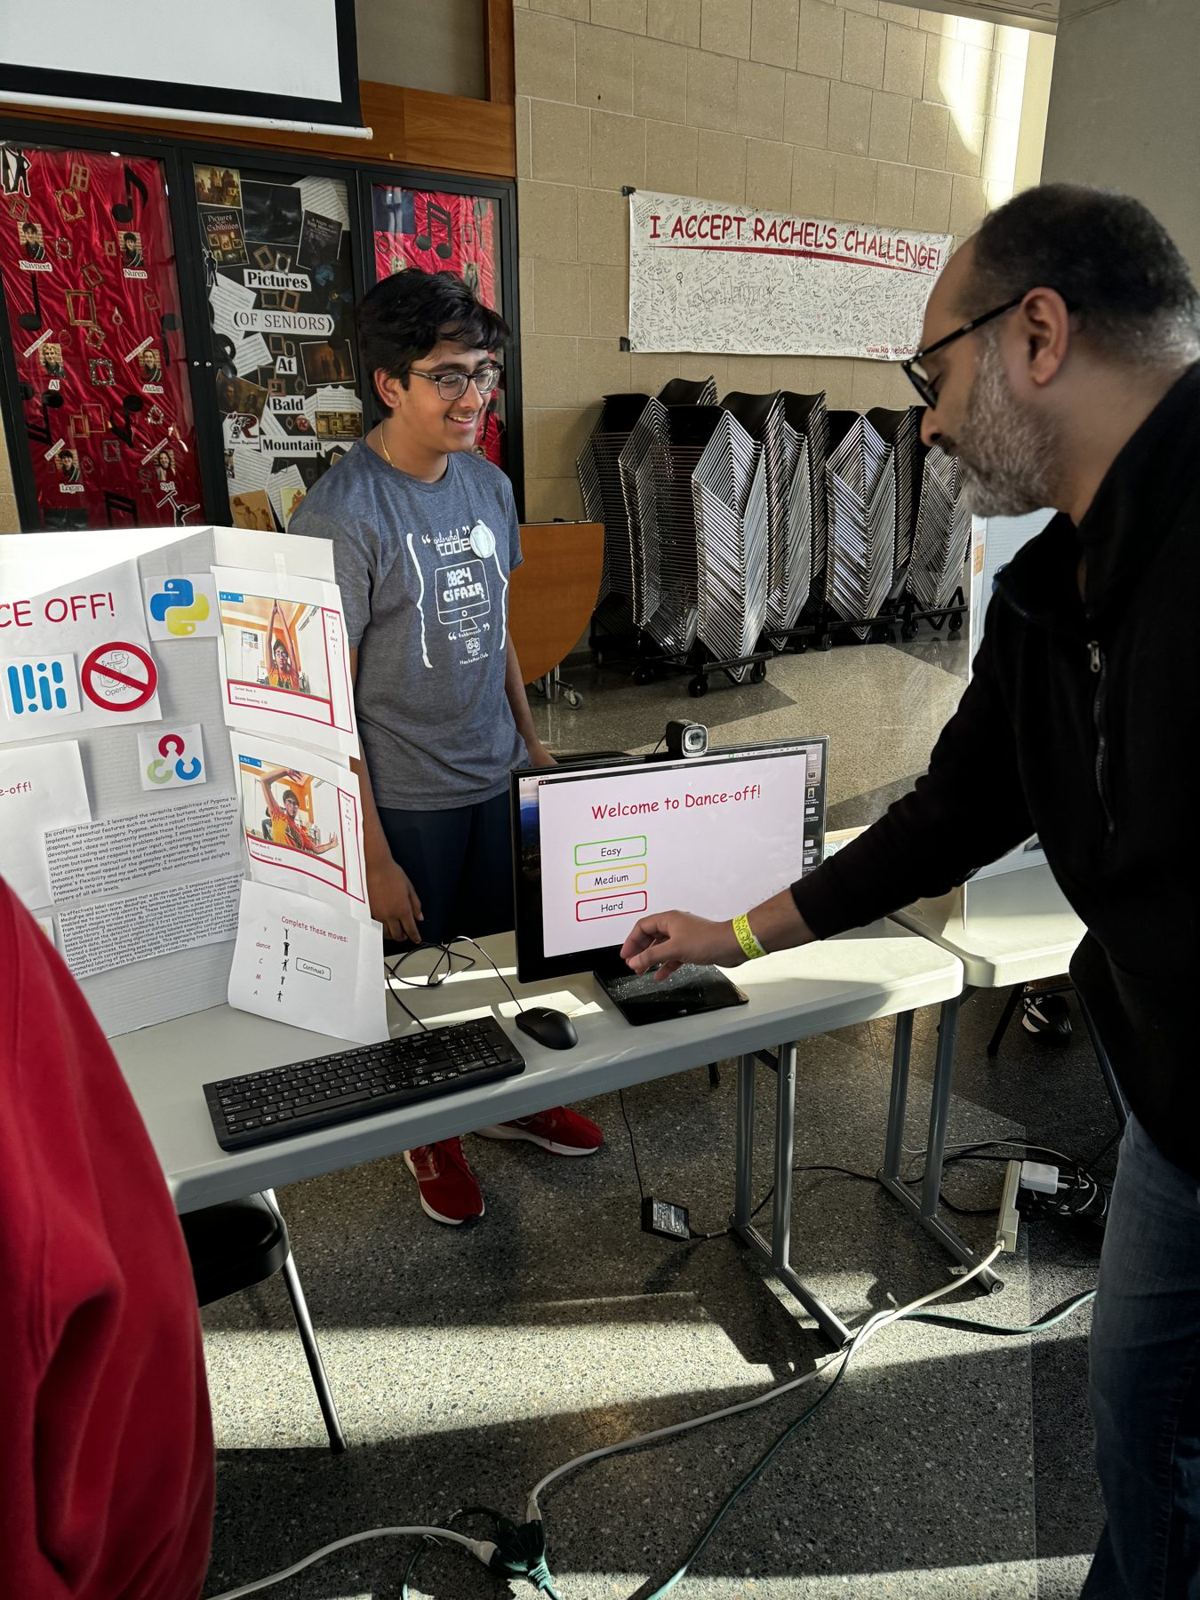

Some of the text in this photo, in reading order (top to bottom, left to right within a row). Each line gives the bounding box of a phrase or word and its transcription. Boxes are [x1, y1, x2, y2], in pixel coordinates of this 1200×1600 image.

[650, 213, 942, 270] I ACCEPT RACHEL'S CHALLENGE!
[248, 272, 308, 289] Pictures
[234, 311, 334, 334] (OF SENIORS)
[278, 358, 293, 372] At
[273, 398, 304, 411] Bald
[262, 439, 322, 452] Mountain
[45, 592, 115, 622] OFF!
[592, 784, 761, 820] Welcome to Dance-off!
[601, 846, 622, 858] Easy
[594, 873, 629, 886] Medium
[601, 901, 624, 912] Hard
[282, 916, 349, 943] Complete these moves:
[256, 942, 271, 950] dance
[302, 963, 324, 976] Continue?
